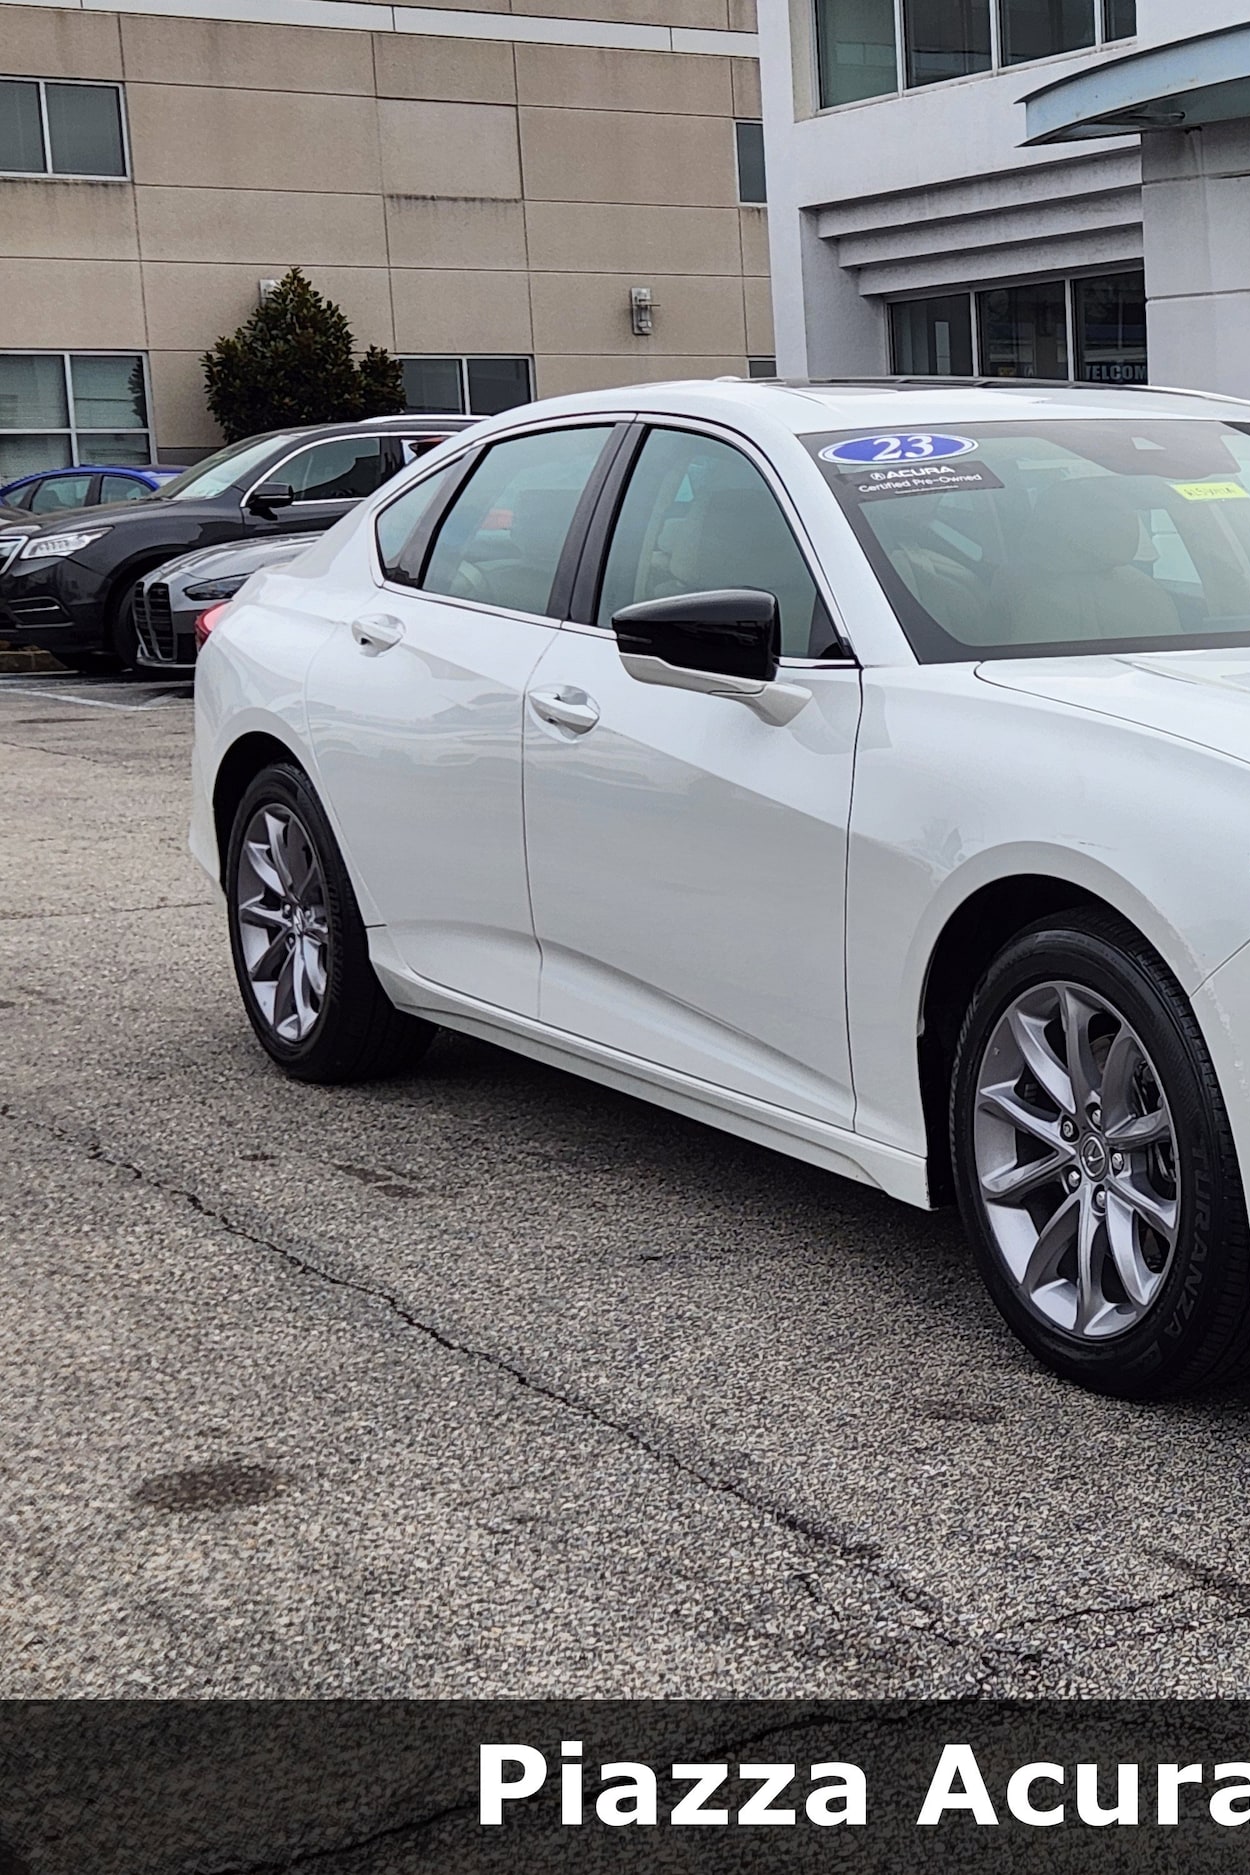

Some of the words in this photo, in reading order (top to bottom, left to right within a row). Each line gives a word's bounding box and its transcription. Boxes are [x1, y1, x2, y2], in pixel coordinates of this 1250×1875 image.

[872, 435, 934, 461] 23
[858, 479, 912, 493] Certified
[912, 473, 983, 486] Pre-Owned
[886, 465, 956, 480] ACURA
[1163, 1146, 1212, 1338] TURANZA
